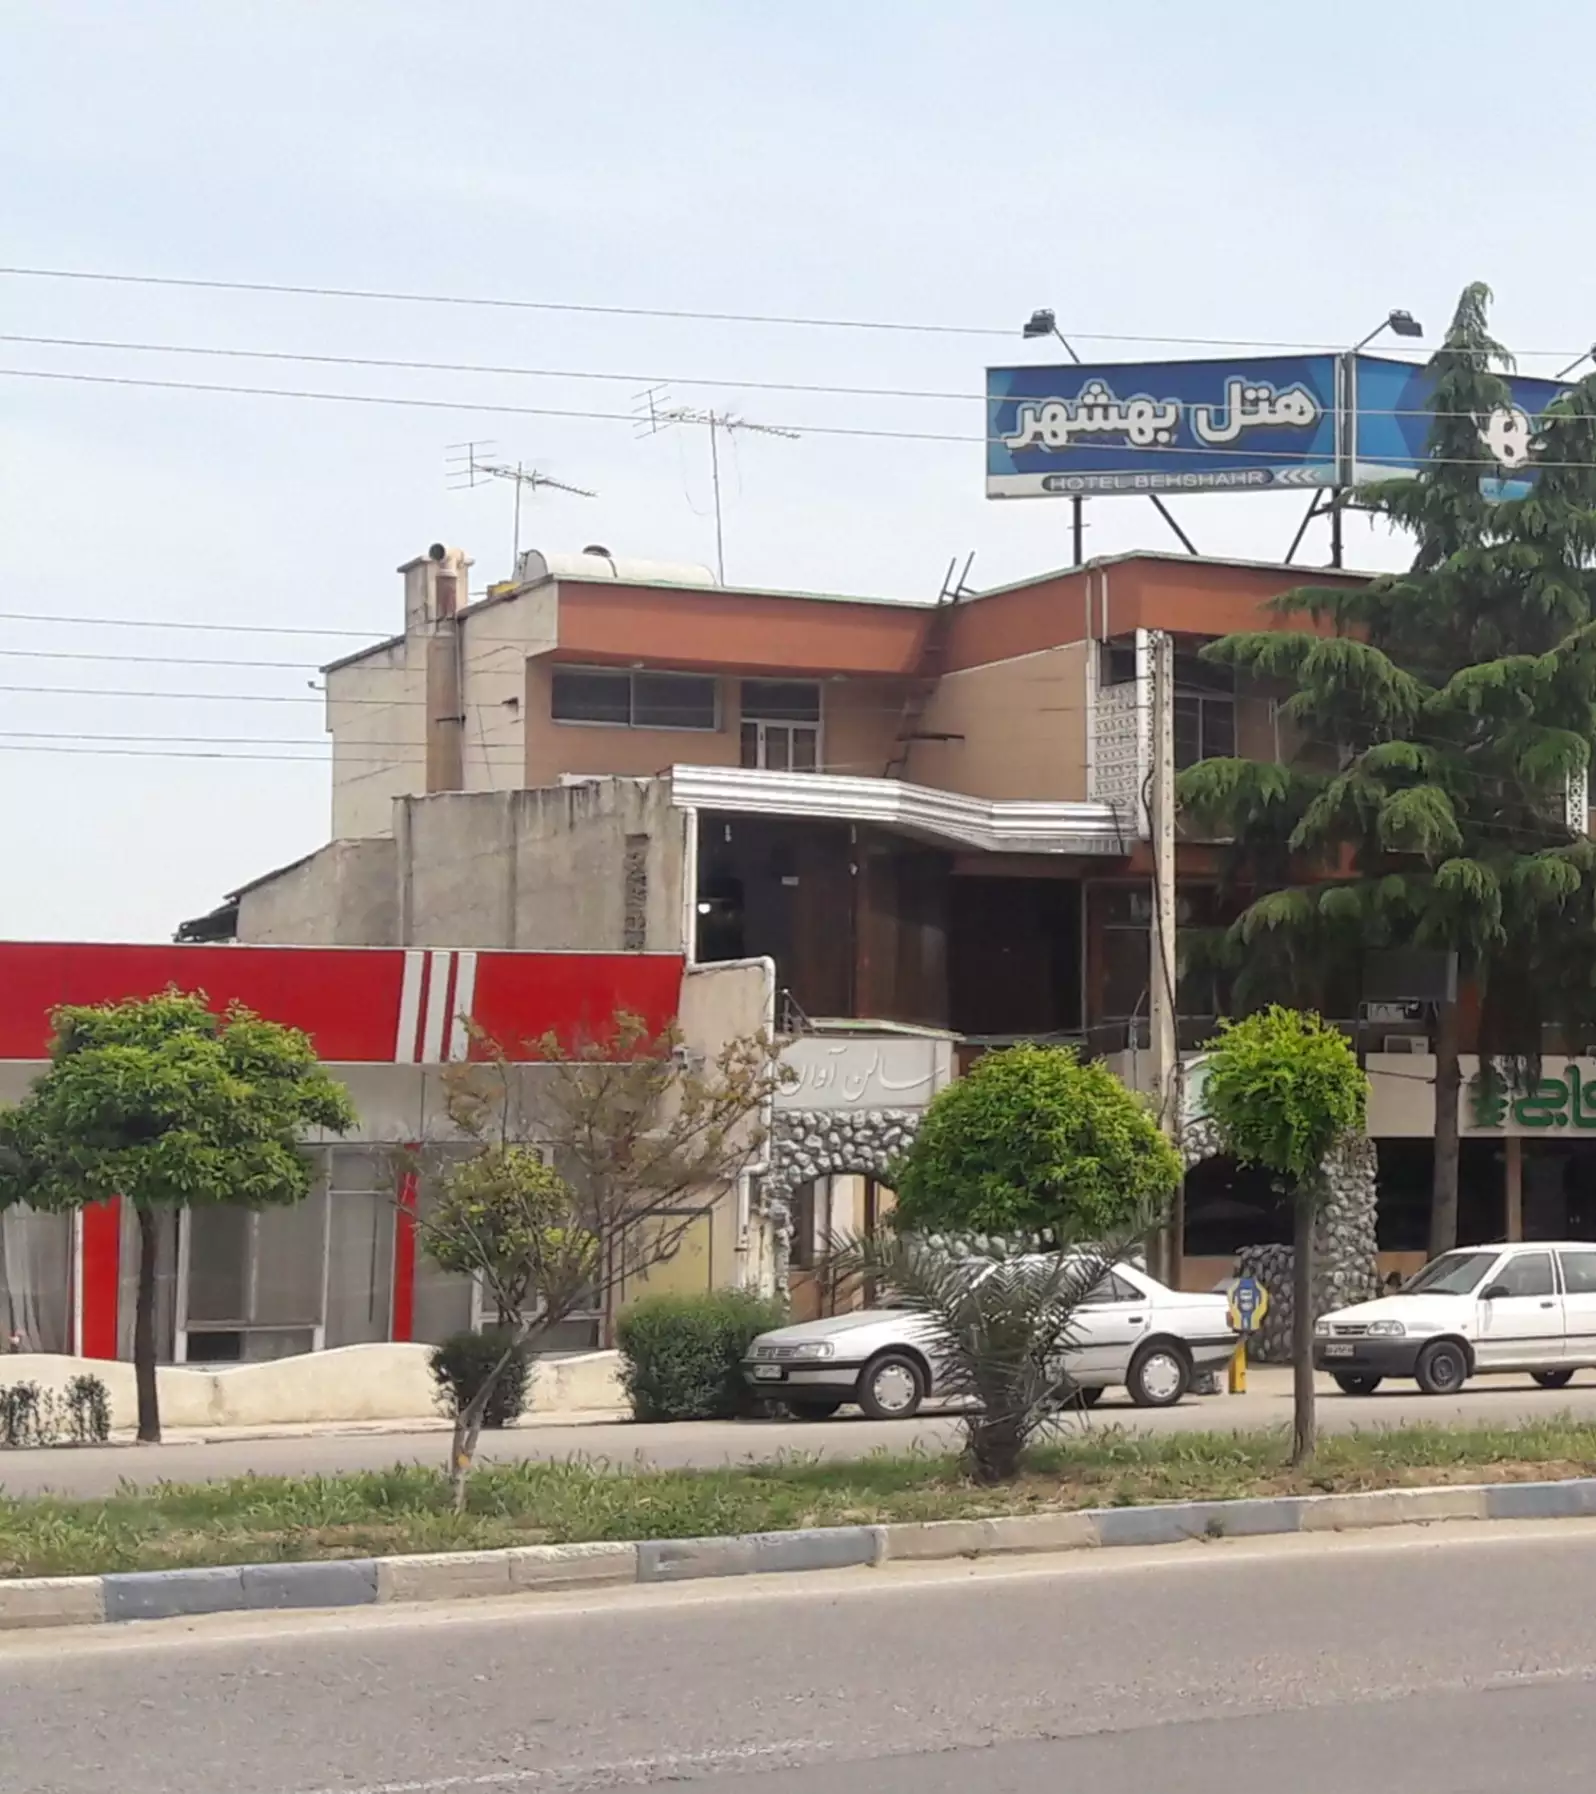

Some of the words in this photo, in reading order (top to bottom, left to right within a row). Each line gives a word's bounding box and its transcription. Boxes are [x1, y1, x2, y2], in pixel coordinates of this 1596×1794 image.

[1004, 381, 1179, 450] بهشهر
[1196, 379, 1318, 444] هتل
[1050, 475, 1128, 490] HOTEL
[1134, 470, 1265, 489] BEHSHAHR
